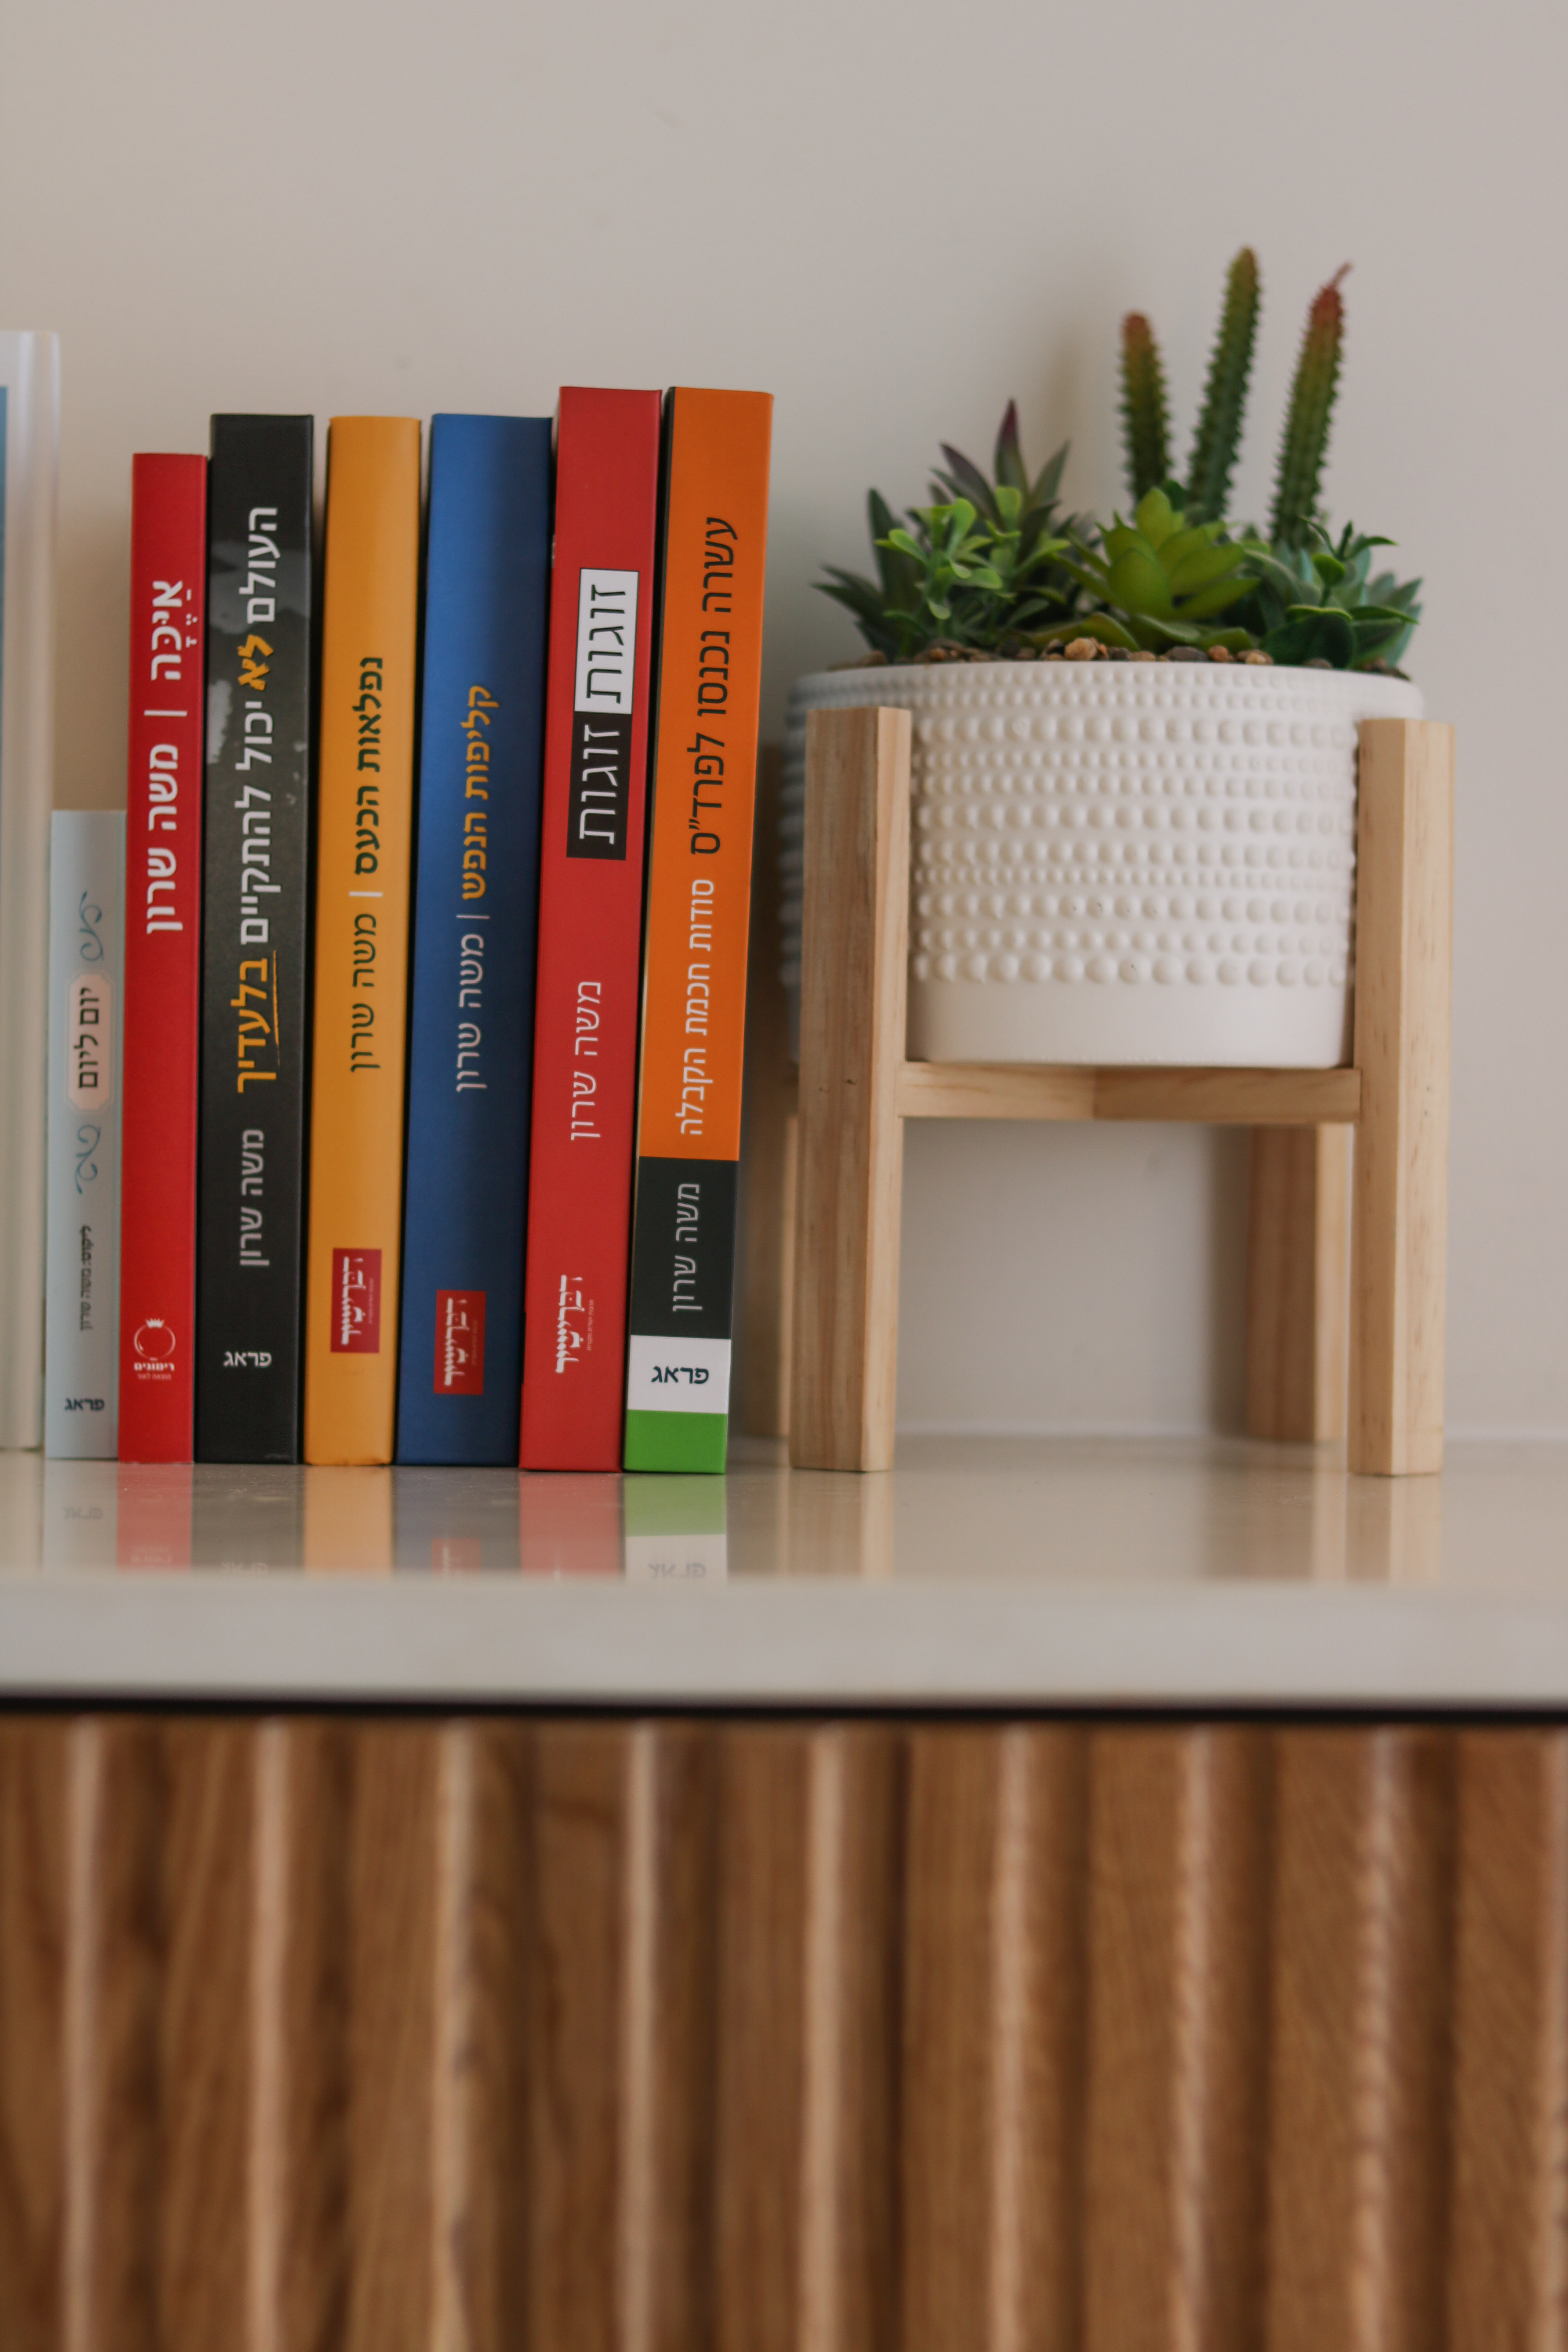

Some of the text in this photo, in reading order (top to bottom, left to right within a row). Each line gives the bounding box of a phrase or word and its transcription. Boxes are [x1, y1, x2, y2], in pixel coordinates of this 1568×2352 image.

[703, 518, 737, 612] עשרה
[586, 584, 626, 704] זוגות
[698, 631, 729, 716] נכנסו
[148, 744, 178, 831] משה
[232, 508, 281, 1093] העולם לא יכול להתקיים בלעדיך
[579, 724, 620, 845] זוגות
[146, 848, 183, 934] שרון
[350, 657, 383, 1073] נפלאות הכעס משה שרון
[456, 686, 498, 1092] קליפות הנפש משה שרון
[74, 987, 99, 1089] יום ליום
[675, 879, 714, 1135] סודות חכמת הקבלה
[570, 982, 601, 1140] משה שרון
[240, 1129, 270, 1266] משה שרון
[672, 1183, 702, 1312] משה שרון
[80, 1269, 91, 1298] משה
[80, 1302, 94, 1331] שרון
[65, 1398, 105, 1411] פראג
[224, 1351, 272, 1367] פראג
[651, 1366, 709, 1385] פראג
